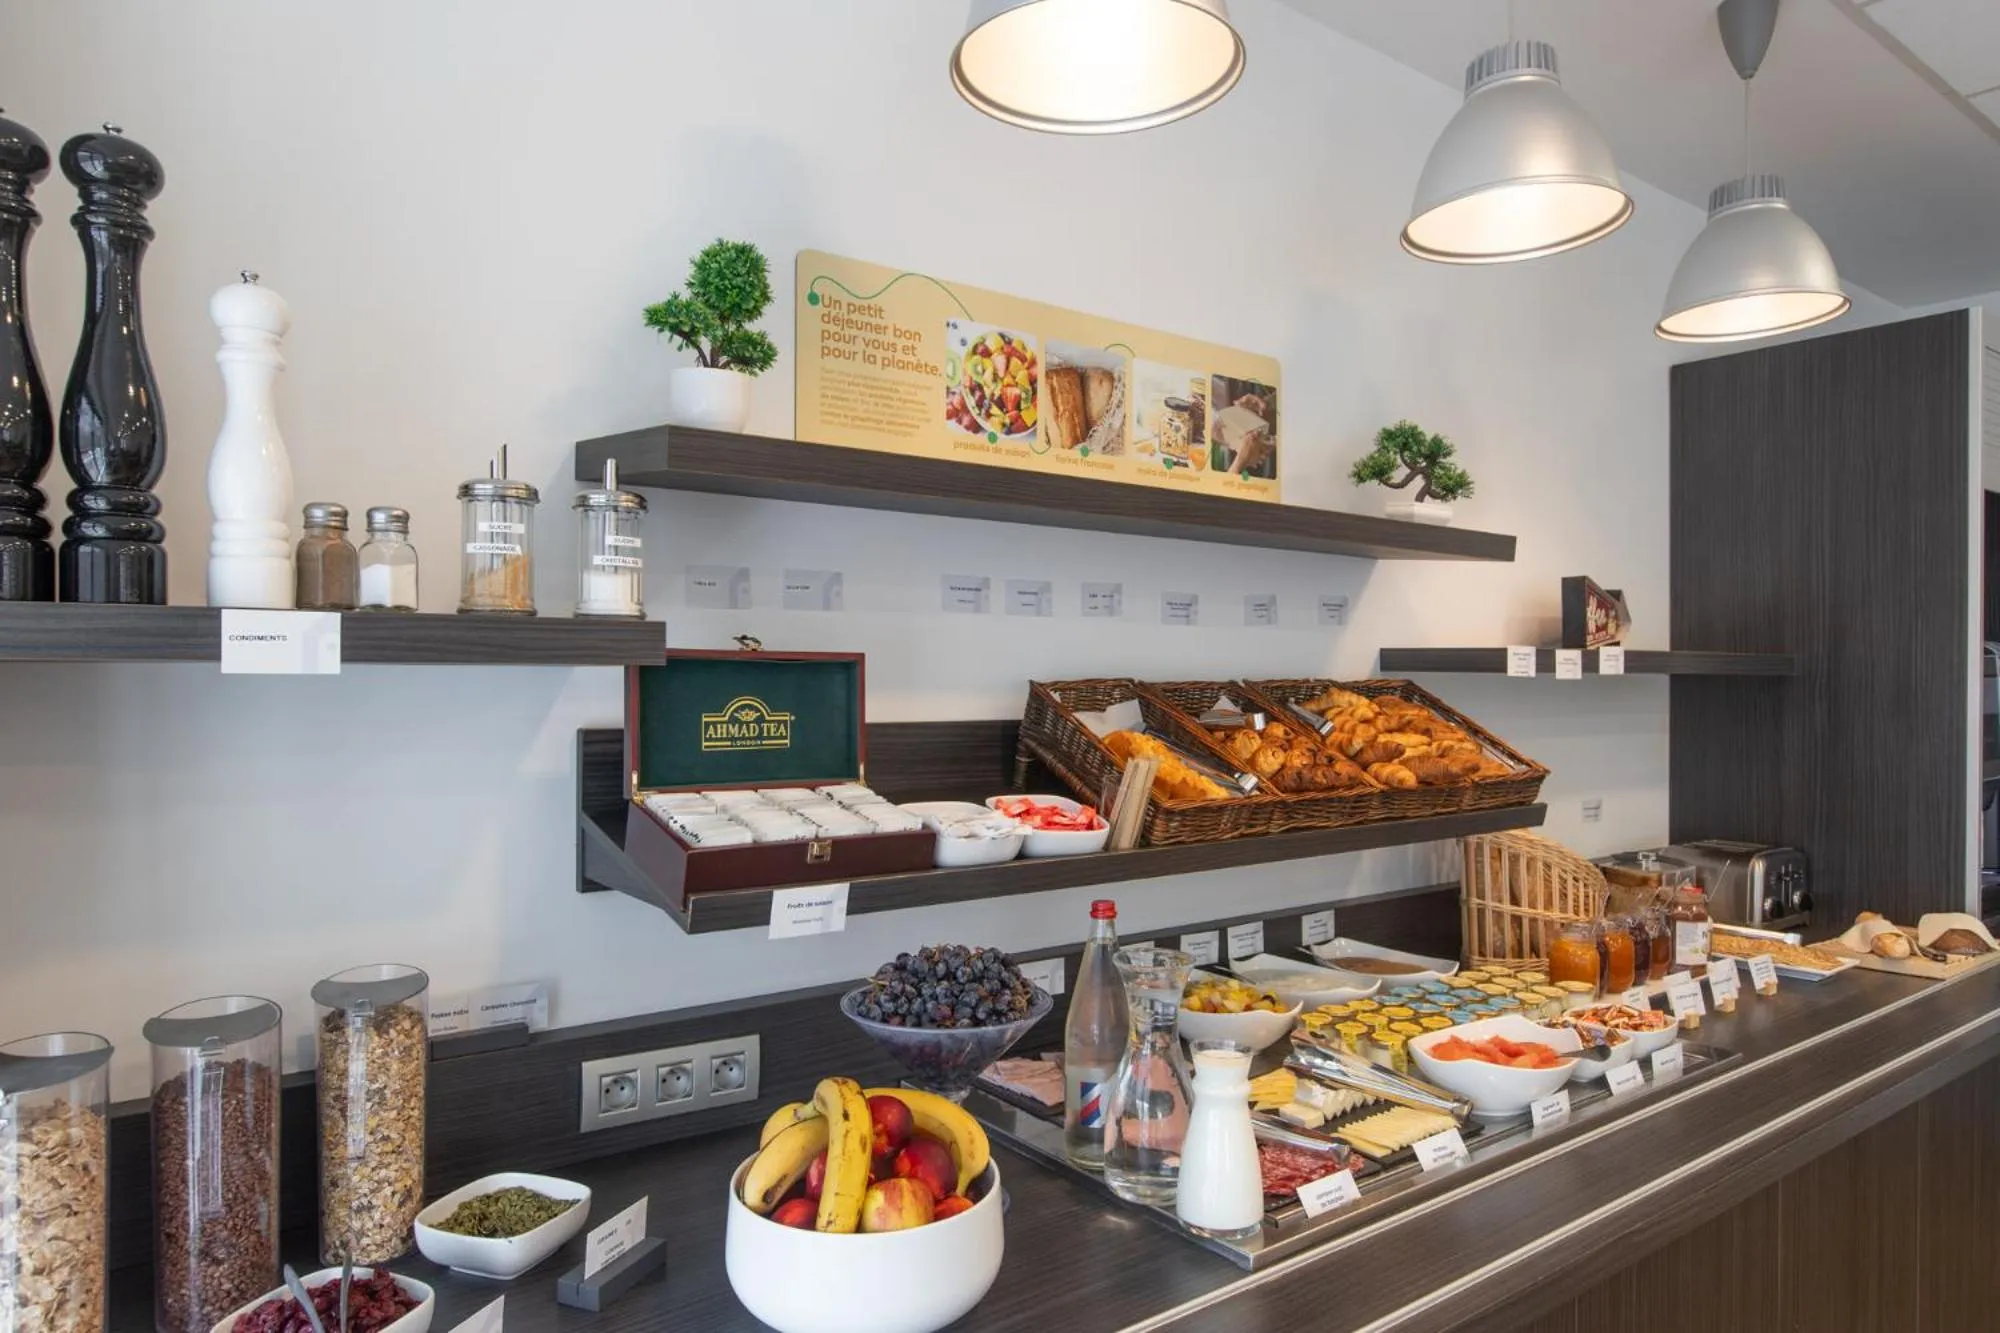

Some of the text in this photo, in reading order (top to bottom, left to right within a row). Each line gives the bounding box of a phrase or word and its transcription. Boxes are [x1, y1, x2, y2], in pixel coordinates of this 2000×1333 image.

[821, 293, 886, 319] Un petit
[820, 310, 922, 343] déjeuner bon
[820, 329, 918, 357] pour vous et
[820, 345, 943, 377] pour la planète.
[489, 523, 513, 531] SUCRE
[228, 634, 289, 642] CONDIMENTS
[705, 722, 787, 738] AHMAD TEA
